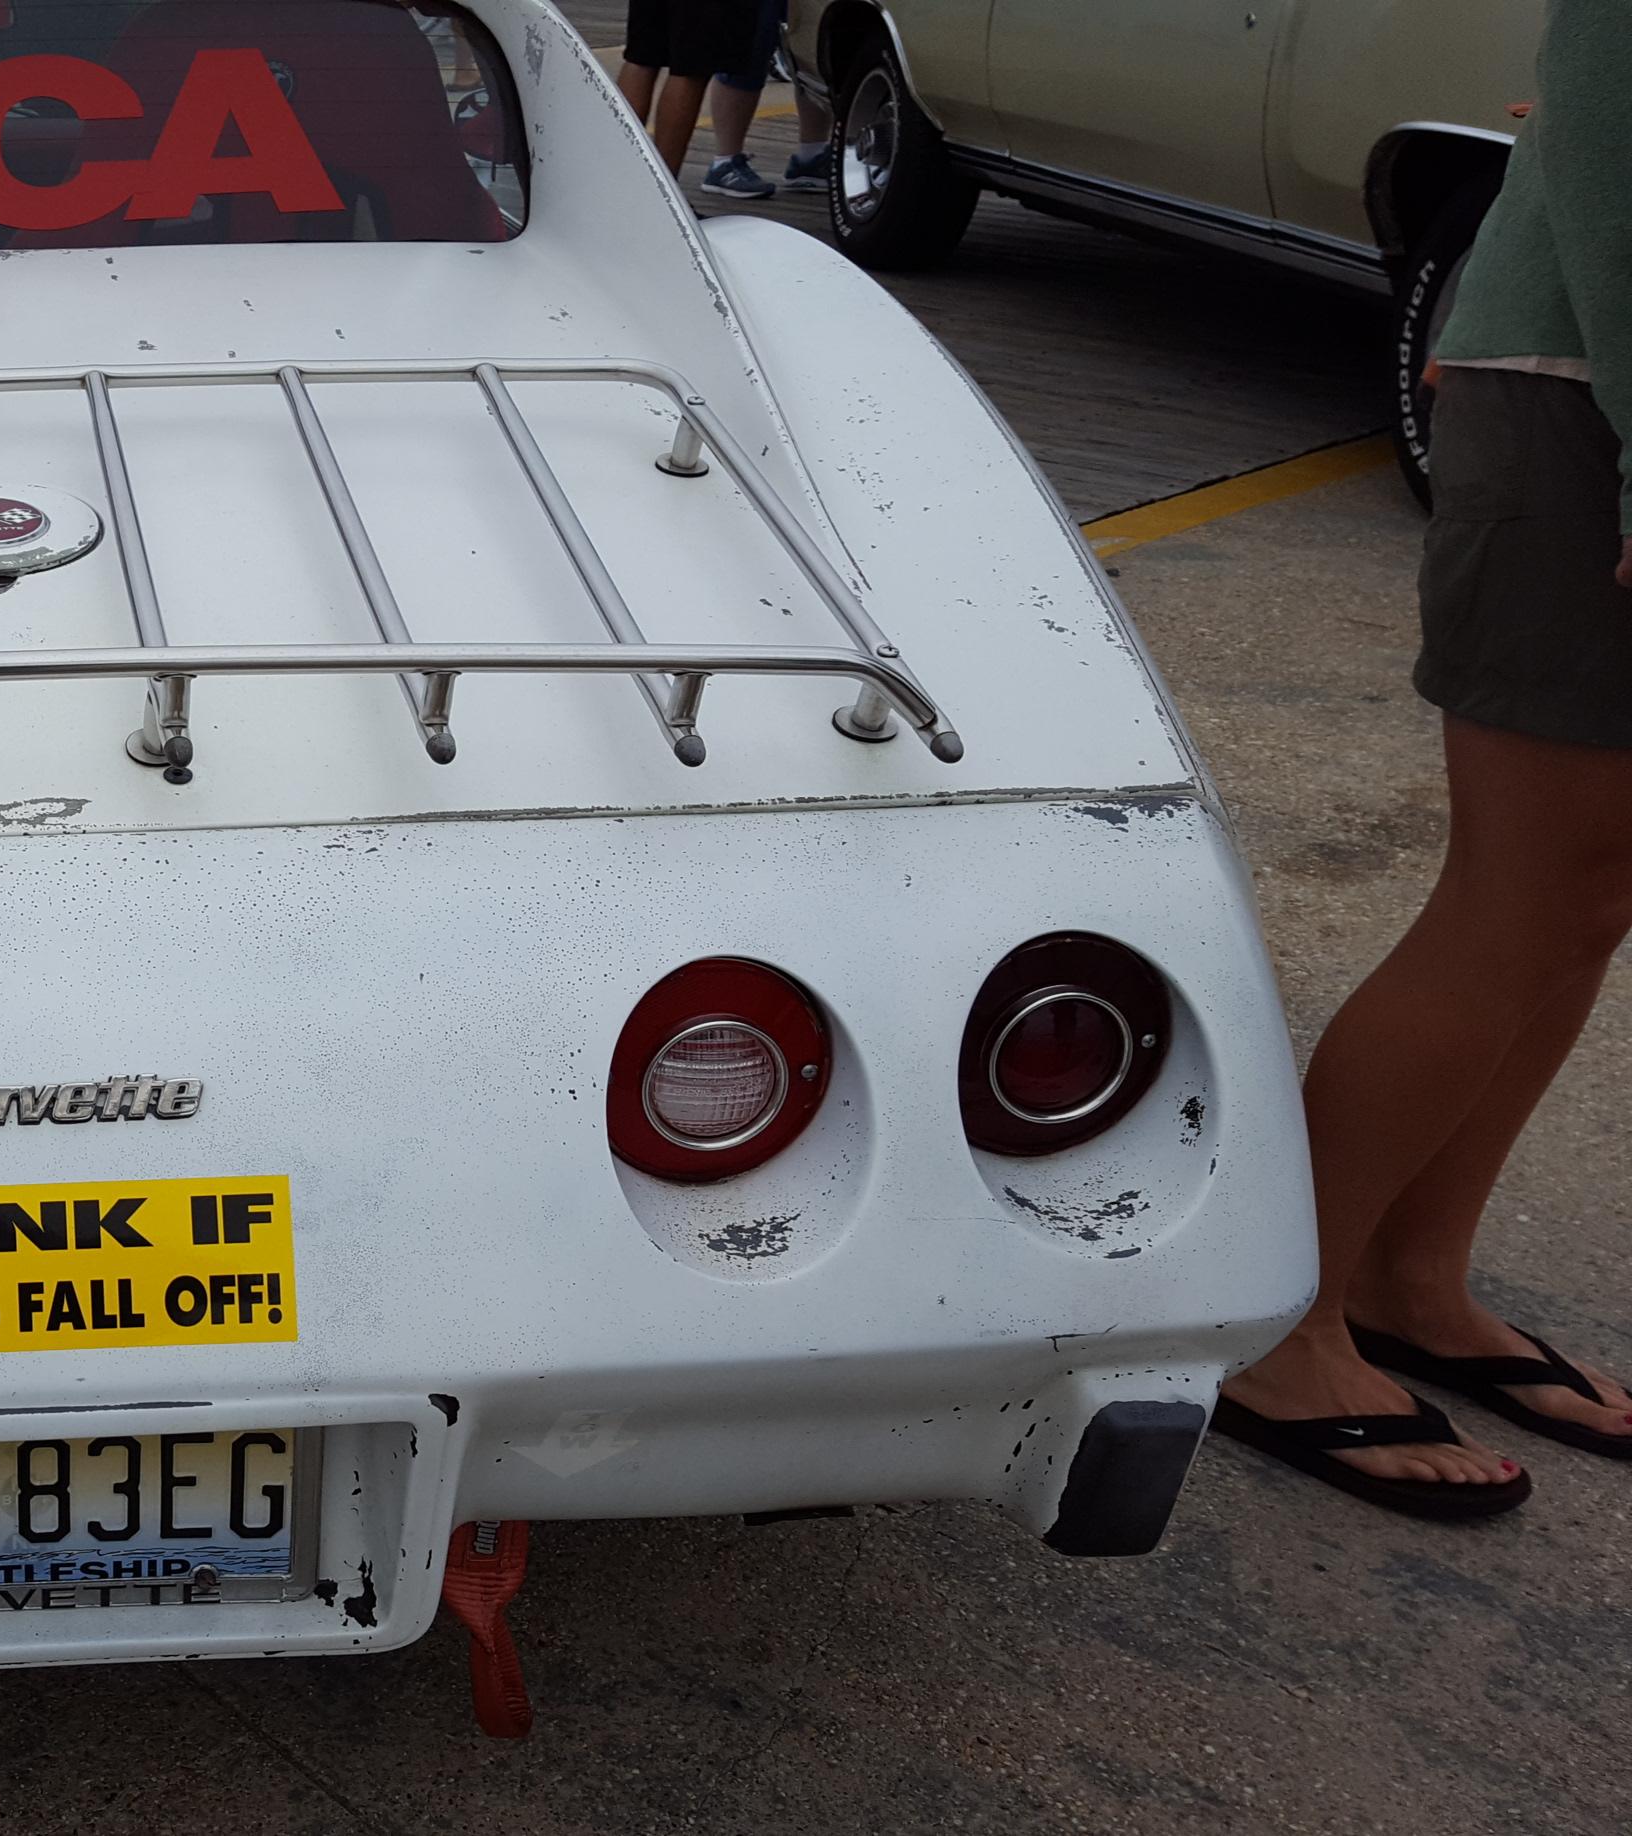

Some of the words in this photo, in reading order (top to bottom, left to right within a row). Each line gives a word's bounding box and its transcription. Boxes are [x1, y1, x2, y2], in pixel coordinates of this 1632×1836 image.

[191, 1193, 274, 1246] IF
[17, 1278, 145, 1333] FALL
[164, 1272, 283, 1327] OFF!
[17, 1431, 286, 1544] 83EG
